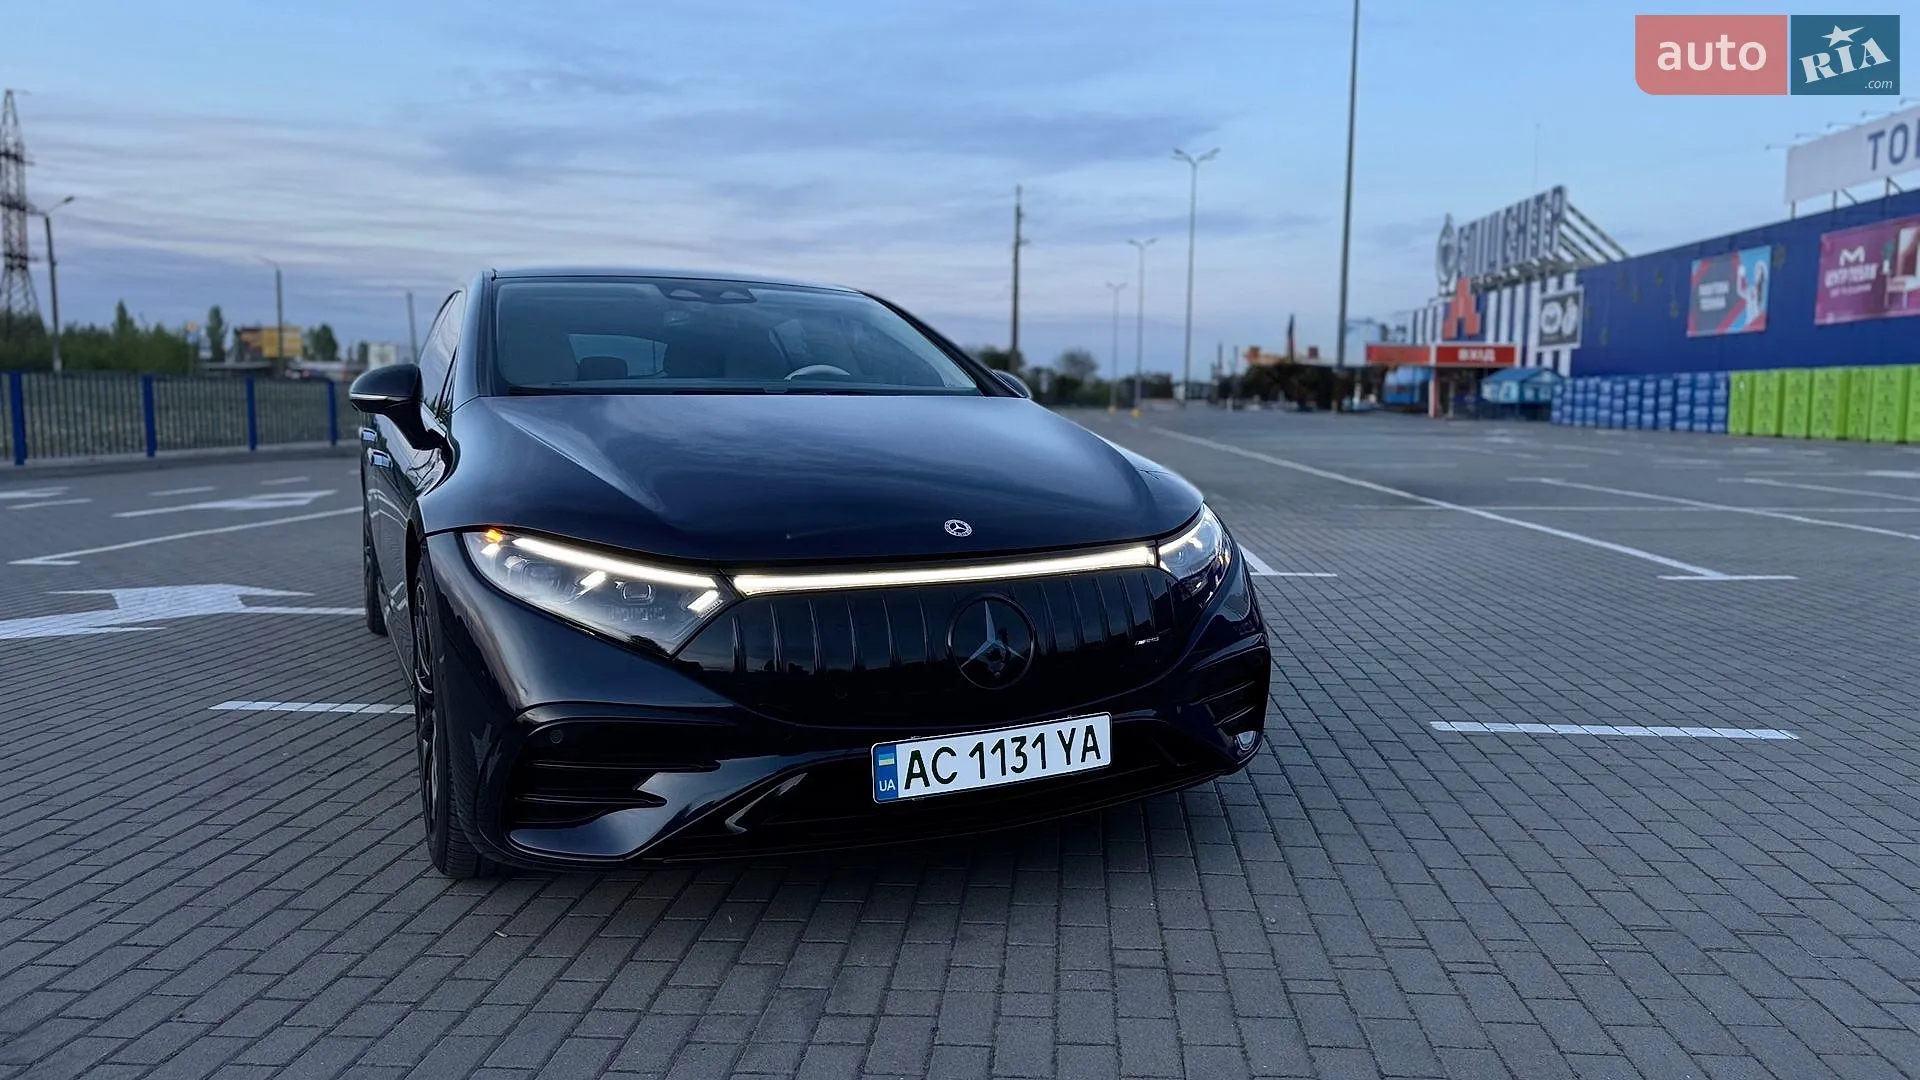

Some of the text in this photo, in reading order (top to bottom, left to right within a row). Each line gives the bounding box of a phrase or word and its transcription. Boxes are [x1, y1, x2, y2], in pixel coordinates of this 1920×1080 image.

[904, 725, 1102, 790] AC 1131 YA
[879, 779, 896, 792] UA
